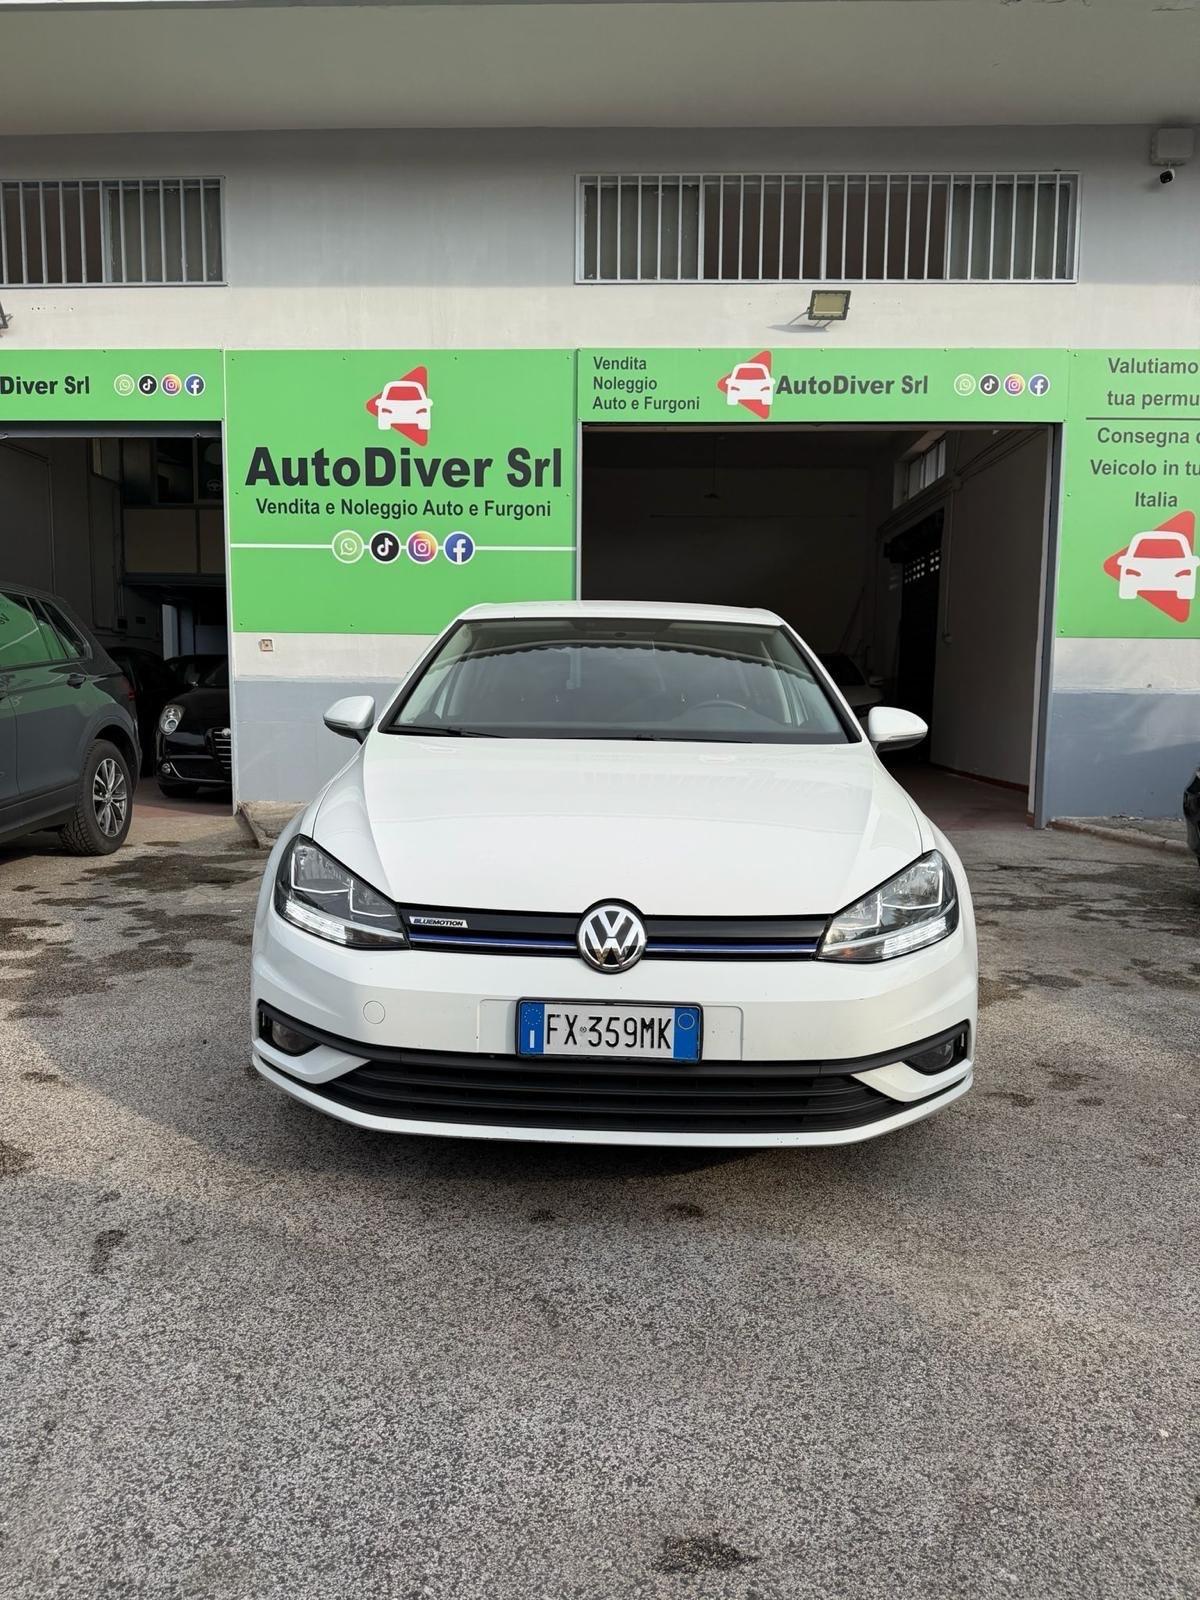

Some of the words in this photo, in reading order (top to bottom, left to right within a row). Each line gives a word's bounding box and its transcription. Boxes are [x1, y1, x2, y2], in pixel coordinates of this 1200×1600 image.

[593, 356, 647, 370] Vendita
[1108, 358, 1199, 374] Valutiamo
[64, 376, 90, 395] Srl
[593, 376, 658, 394] Noleggio
[775, 375, 895, 395] AutoDiver
[901, 375, 928, 394] Srl
[592, 396, 627, 410] Auto
[631, 399, 640, 410] e
[644, 396, 700, 414] Furgoni
[1107, 391, 1136, 406] tua
[1142, 394, 1200, 410] permu
[1097, 427, 1189, 448] Consegna
[245, 446, 493, 488] AutoDiver
[507, 447, 562, 488] Srl
[1090, 459, 1157, 476] Veicolo
[1163, 459, 1179, 476] in
[1135, 491, 1178, 507] Italia
[256, 498, 320, 515] Vendita
[325, 503, 335, 515] e
[341, 499, 418, 520] Noleggio
[422, 500, 464, 516] Auto
[469, 504, 479, 516] e
[484, 501, 551, 521] Furgoni
[412, 917, 464, 928] BLUEMOTION
